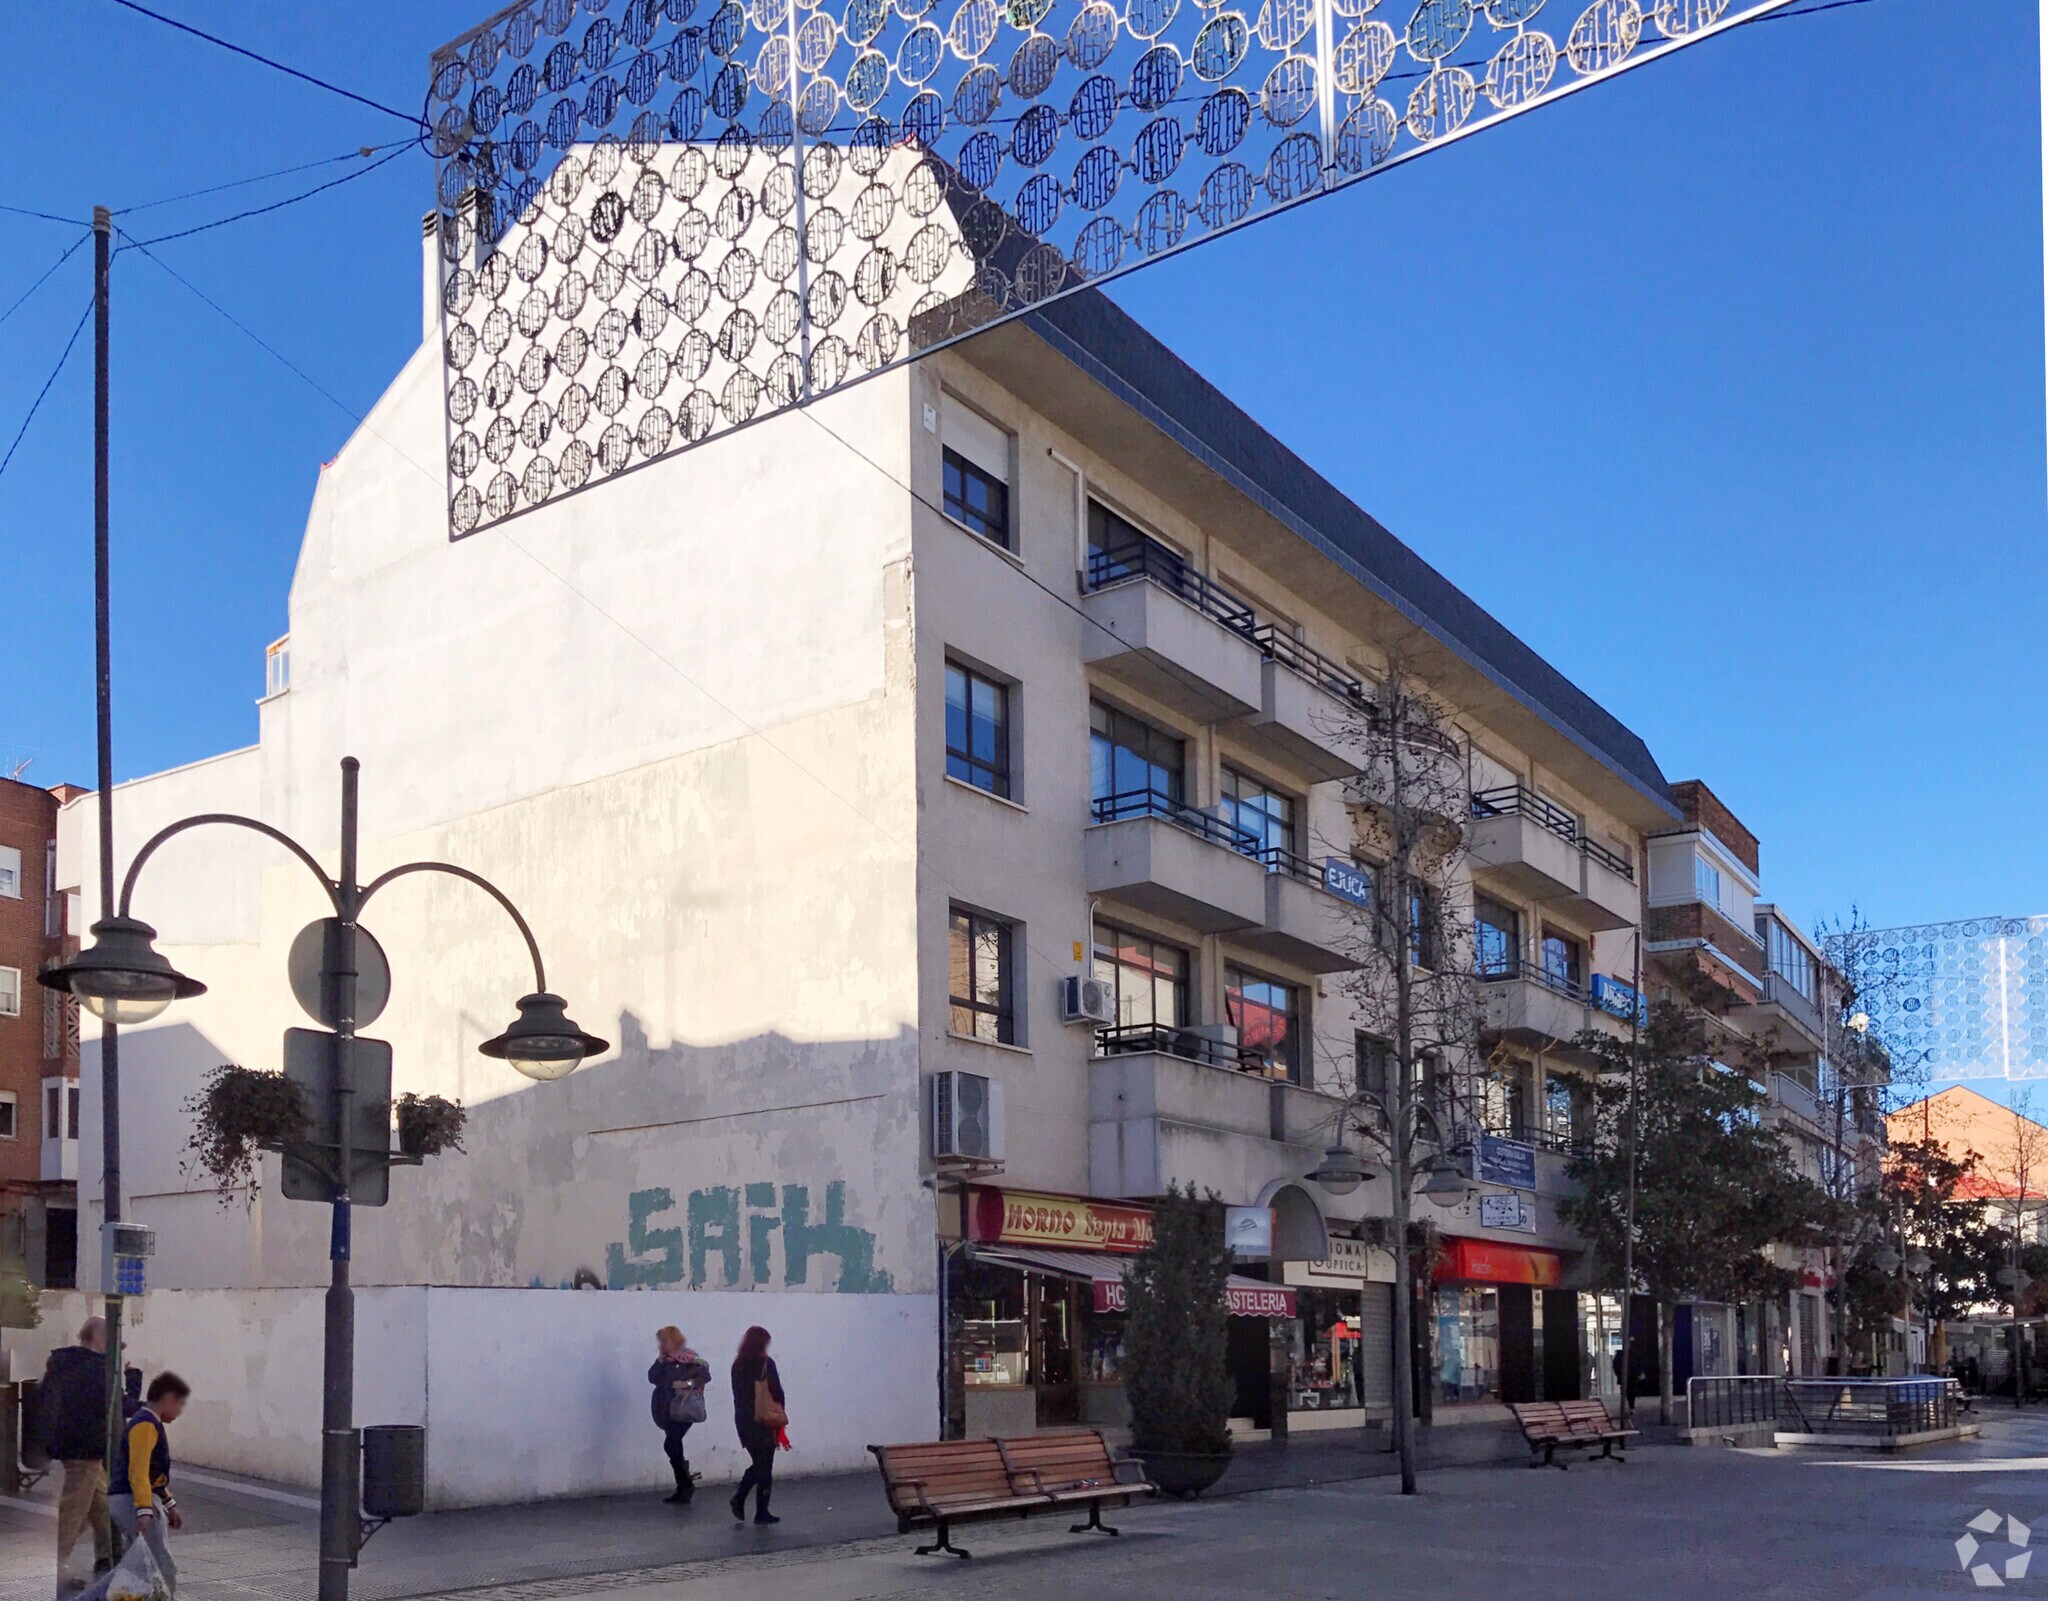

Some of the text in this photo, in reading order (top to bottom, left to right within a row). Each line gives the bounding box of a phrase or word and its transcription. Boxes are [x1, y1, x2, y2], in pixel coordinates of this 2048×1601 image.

[1007, 1204, 1076, 1235] HORNO
[1084, 1211, 1127, 1244] Santa
[1224, 1291, 1287, 1311] ASTELERIA
